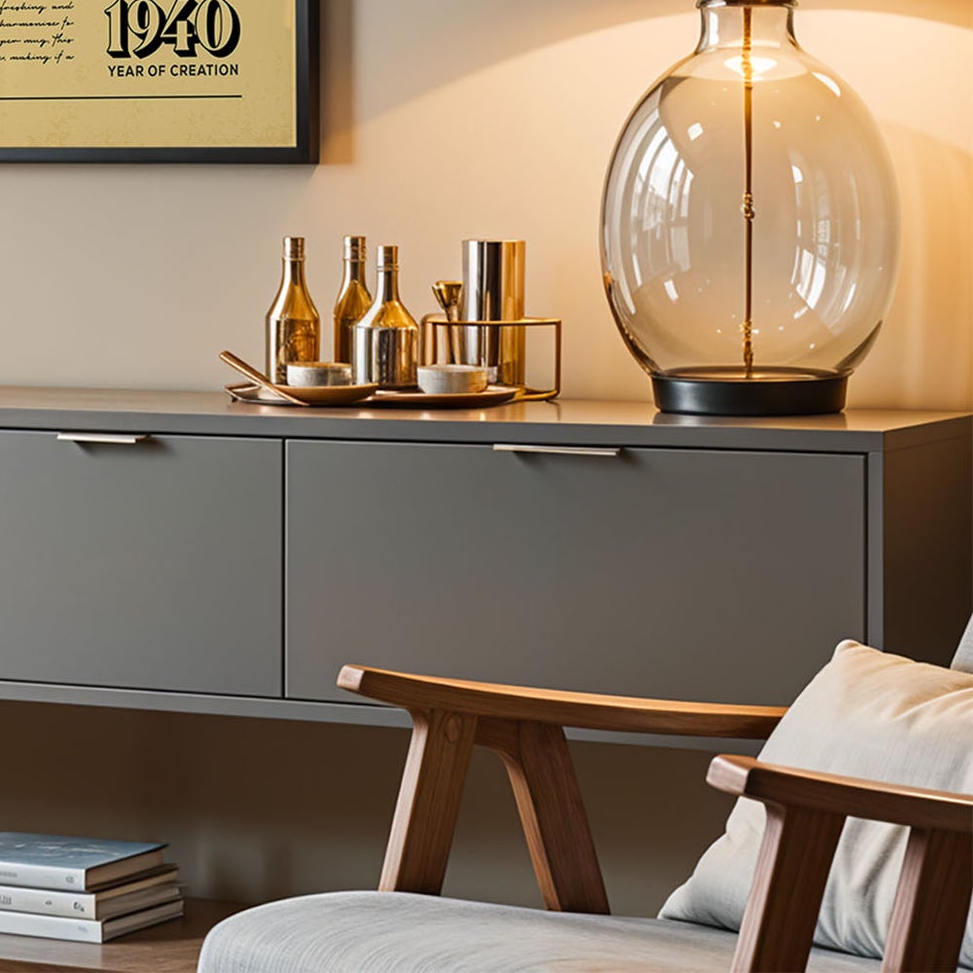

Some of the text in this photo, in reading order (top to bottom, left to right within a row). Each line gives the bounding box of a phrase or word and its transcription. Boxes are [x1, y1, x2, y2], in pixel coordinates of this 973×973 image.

[52, 1, 74, 10] and
[61, 16, 74, 30] to
[52, 33, 74, 47] this
[10, 52, 52, 64] making
[54, 50, 64, 64] it
[108, 64, 239, 77] YEAR OF CREATION
